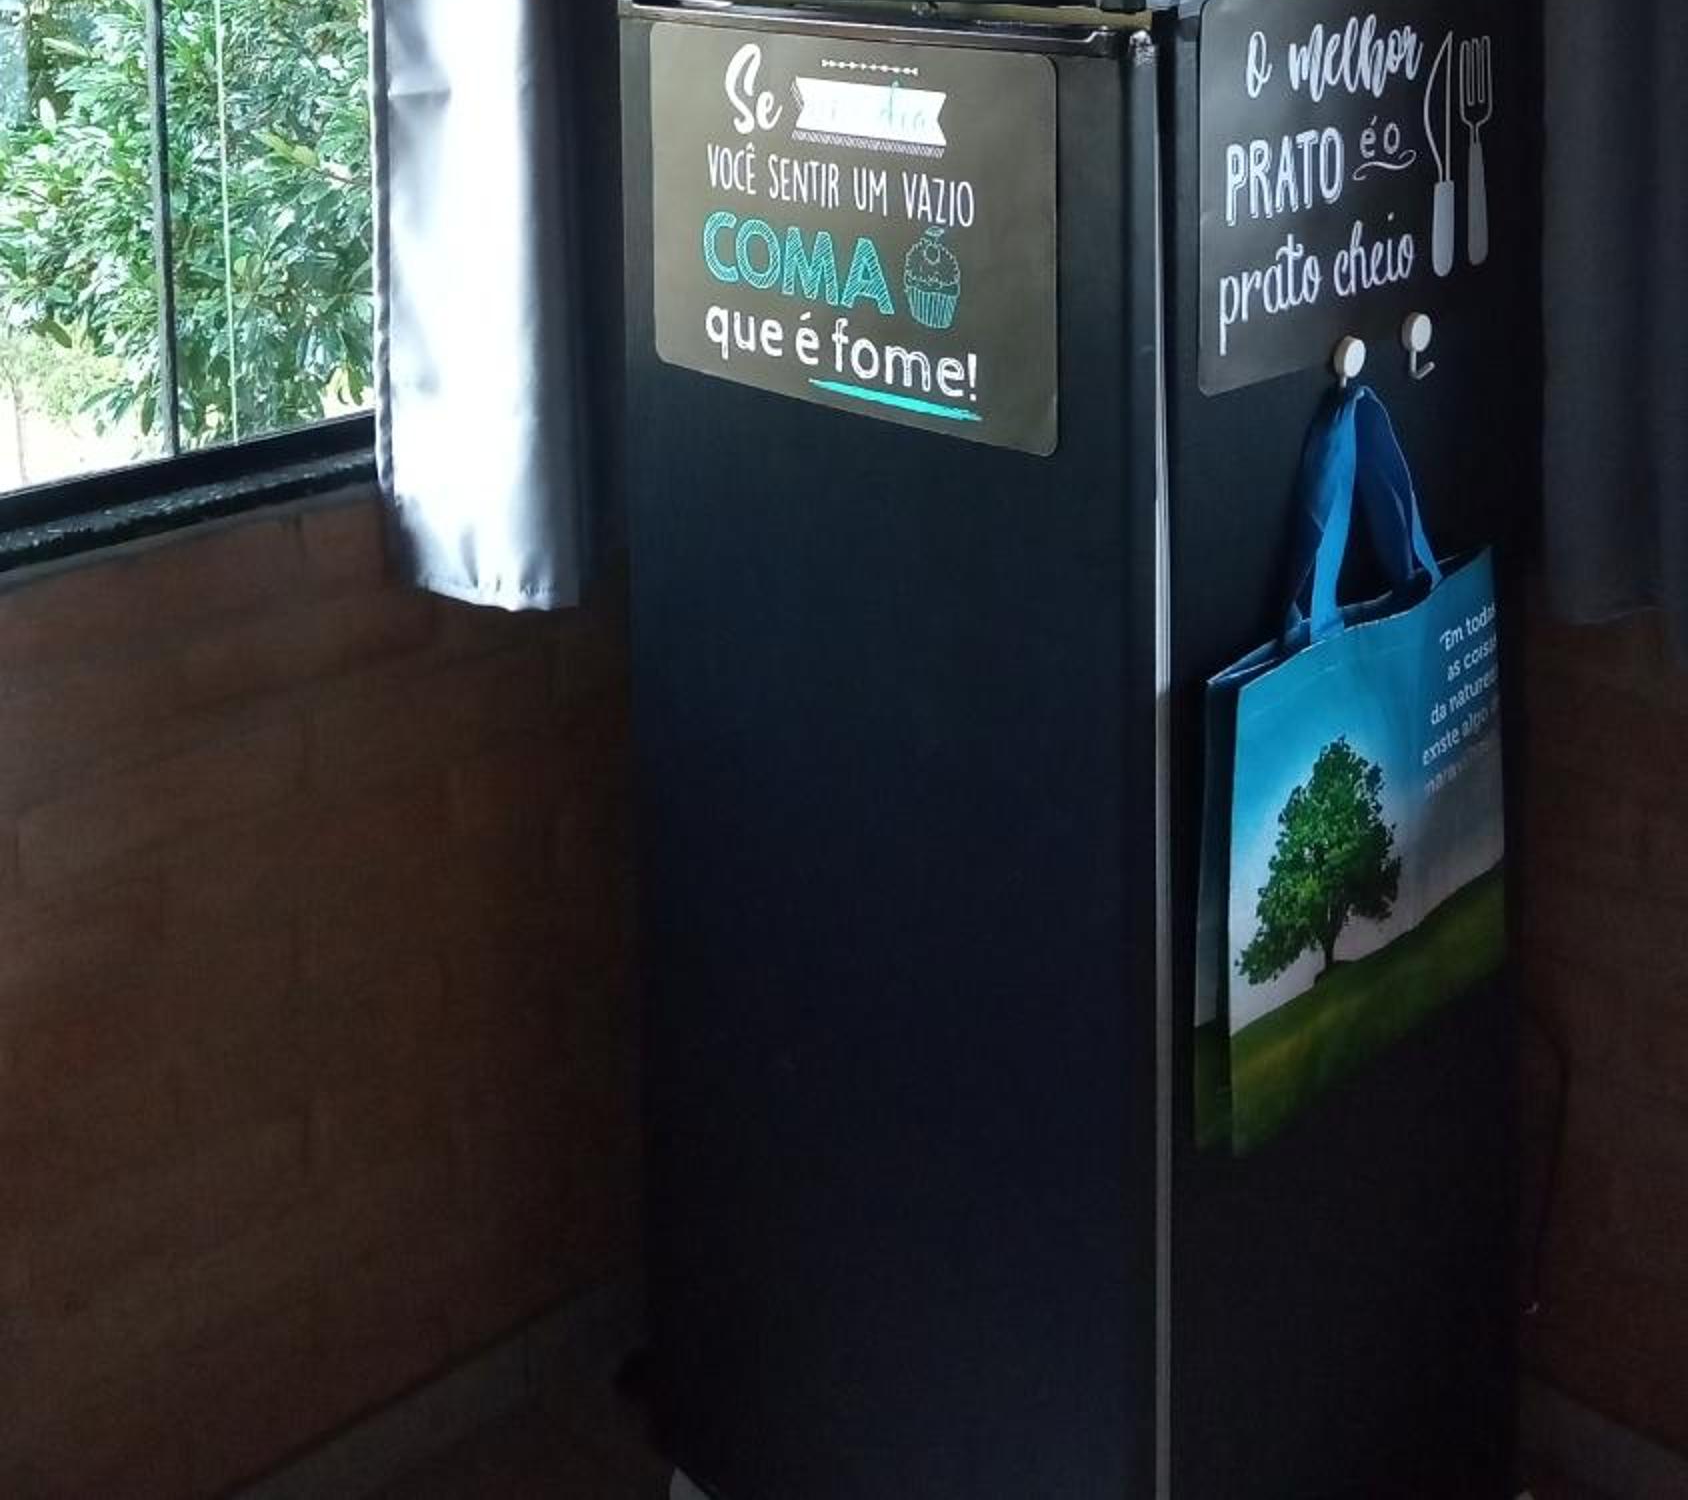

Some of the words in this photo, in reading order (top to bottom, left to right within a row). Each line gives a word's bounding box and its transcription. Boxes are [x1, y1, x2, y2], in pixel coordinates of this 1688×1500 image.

[724, 43, 783, 135] Se
[1288, 13, 1424, 103] melhor
[707, 141, 757, 197] VOCÊ
[768, 153, 840, 209] SENTIR
[853, 167, 888, 217] UM
[902, 170, 975, 228] VAZIO
[1225, 126, 1345, 227] PRATO
[703, 210, 895, 316] COMA
[1219, 233, 1323, 357] prato
[1333, 211, 1415, 298] cheio
[704, 304, 783, 360] que
[795, 311, 820, 367] é
[831, 317, 978, 402] fome!
[1431, 703, 1448, 726] da
[1447, 658, 1461, 682] as
[1422, 729, 1460, 767] existe
